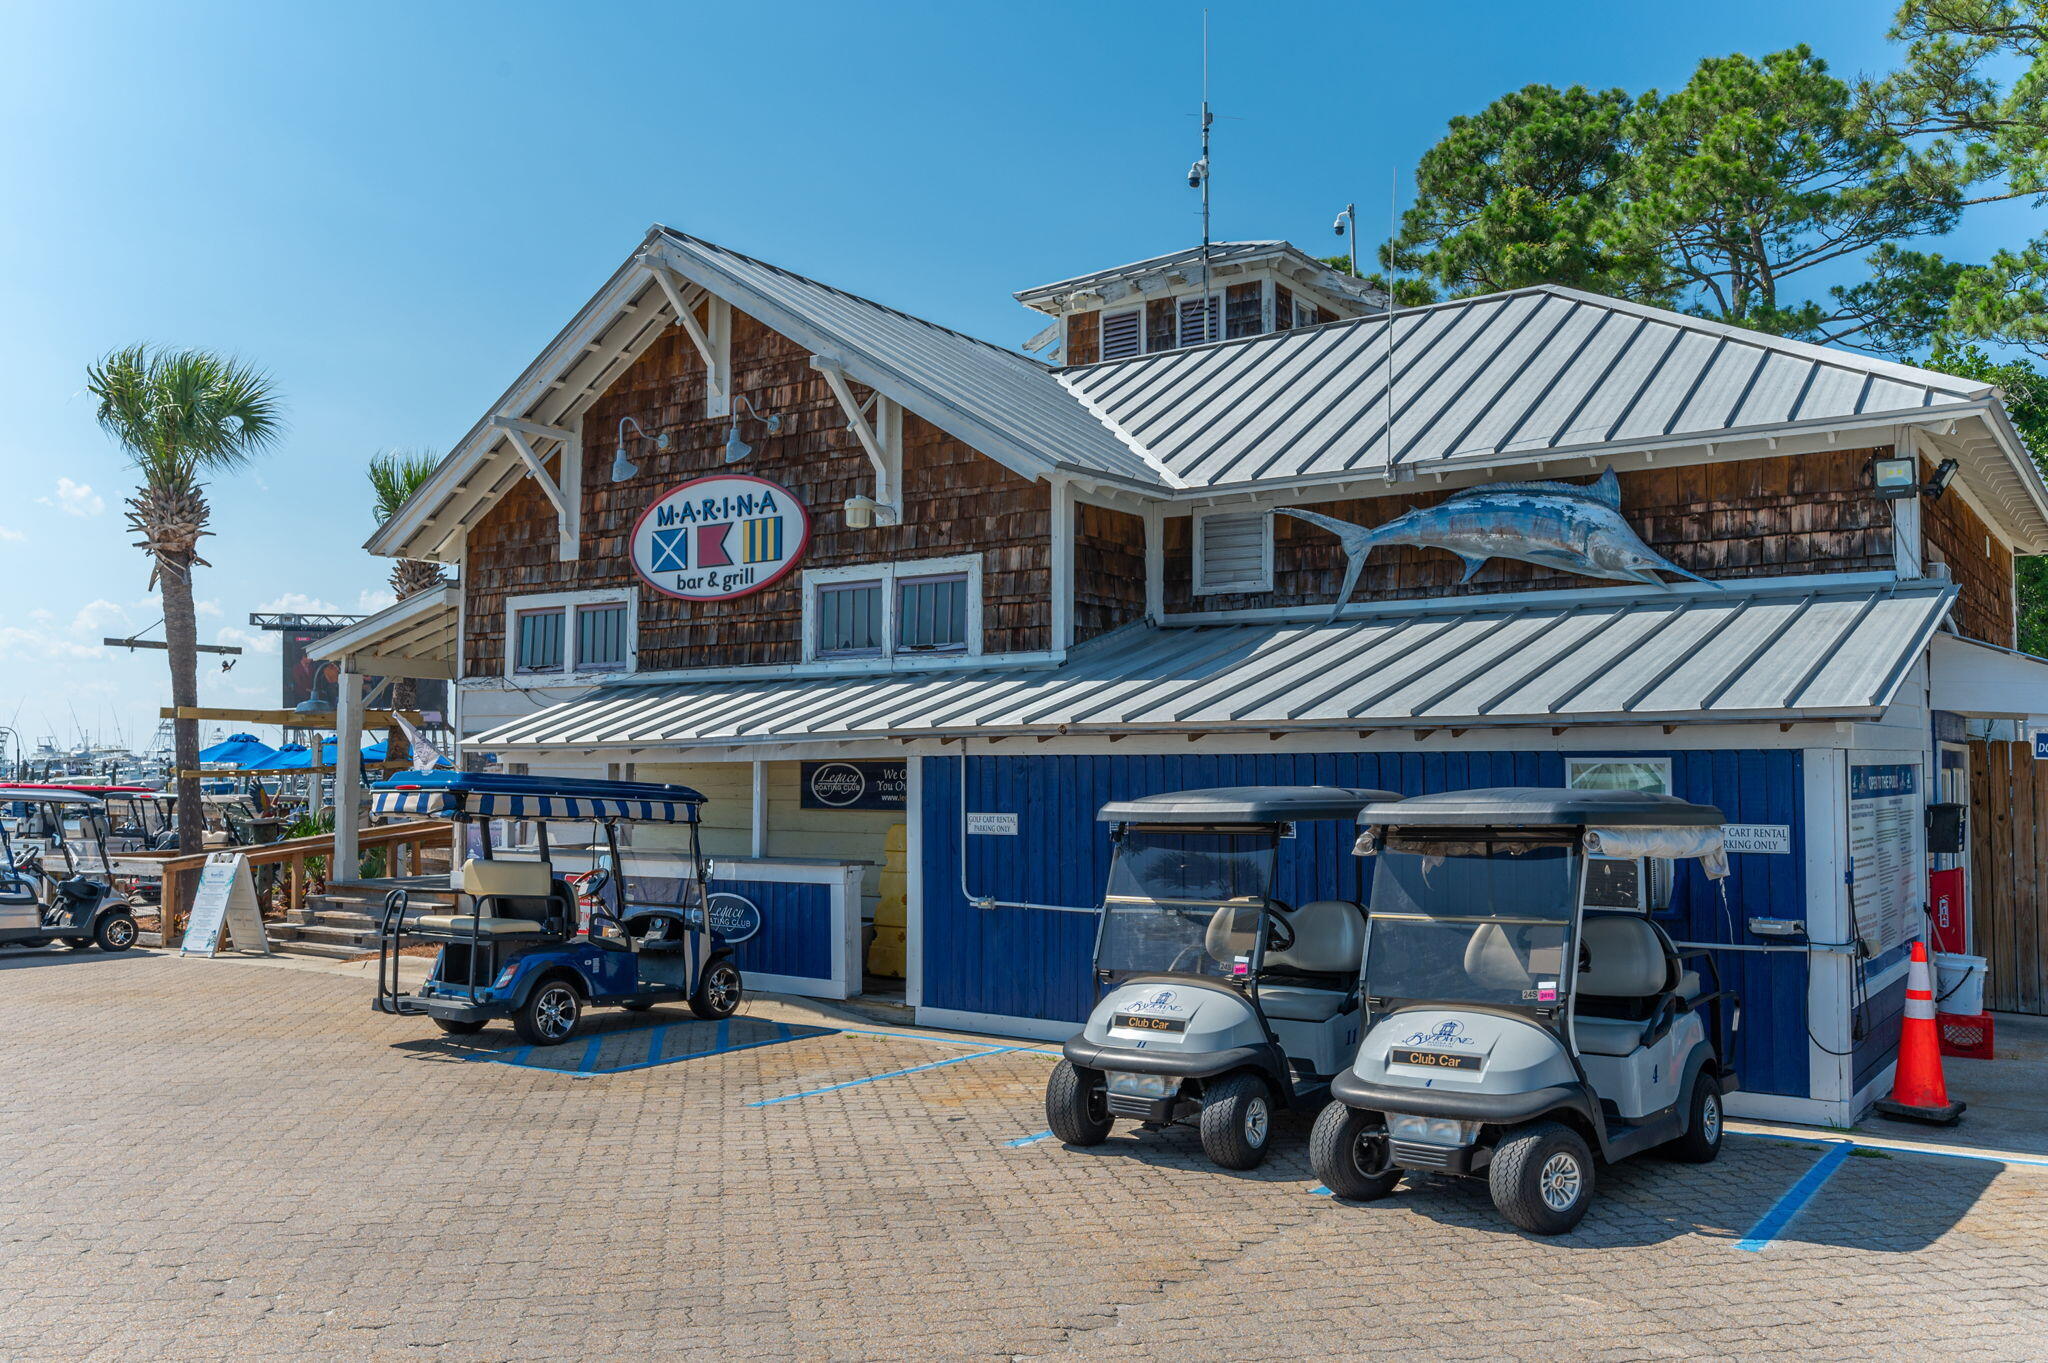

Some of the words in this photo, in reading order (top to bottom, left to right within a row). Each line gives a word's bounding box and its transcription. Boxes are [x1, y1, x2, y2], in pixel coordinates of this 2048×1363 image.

[677, 574, 704, 591] bar
[707, 571, 719, 587] &
[722, 567, 754, 591] grill
[819, 768, 859, 791] Legacy
[883, 769, 898, 779] We
[876, 780, 893, 791] You
[997, 816, 1016, 824] RENTAL
[1729, 828, 1751, 837] CART
[1754, 829, 1786, 838] RENTAL
[1724, 840, 1751, 849] RKING
[1754, 841, 1778, 850] ONLY
[709, 899, 744, 919] Legacy
[732, 919, 751, 927] CLUB
[1128, 1017, 1149, 1027] Club
[1151, 1019, 1170, 1029] Car
[1410, 1053, 1436, 1065] Club
[1439, 1055, 1462, 1067] Car
